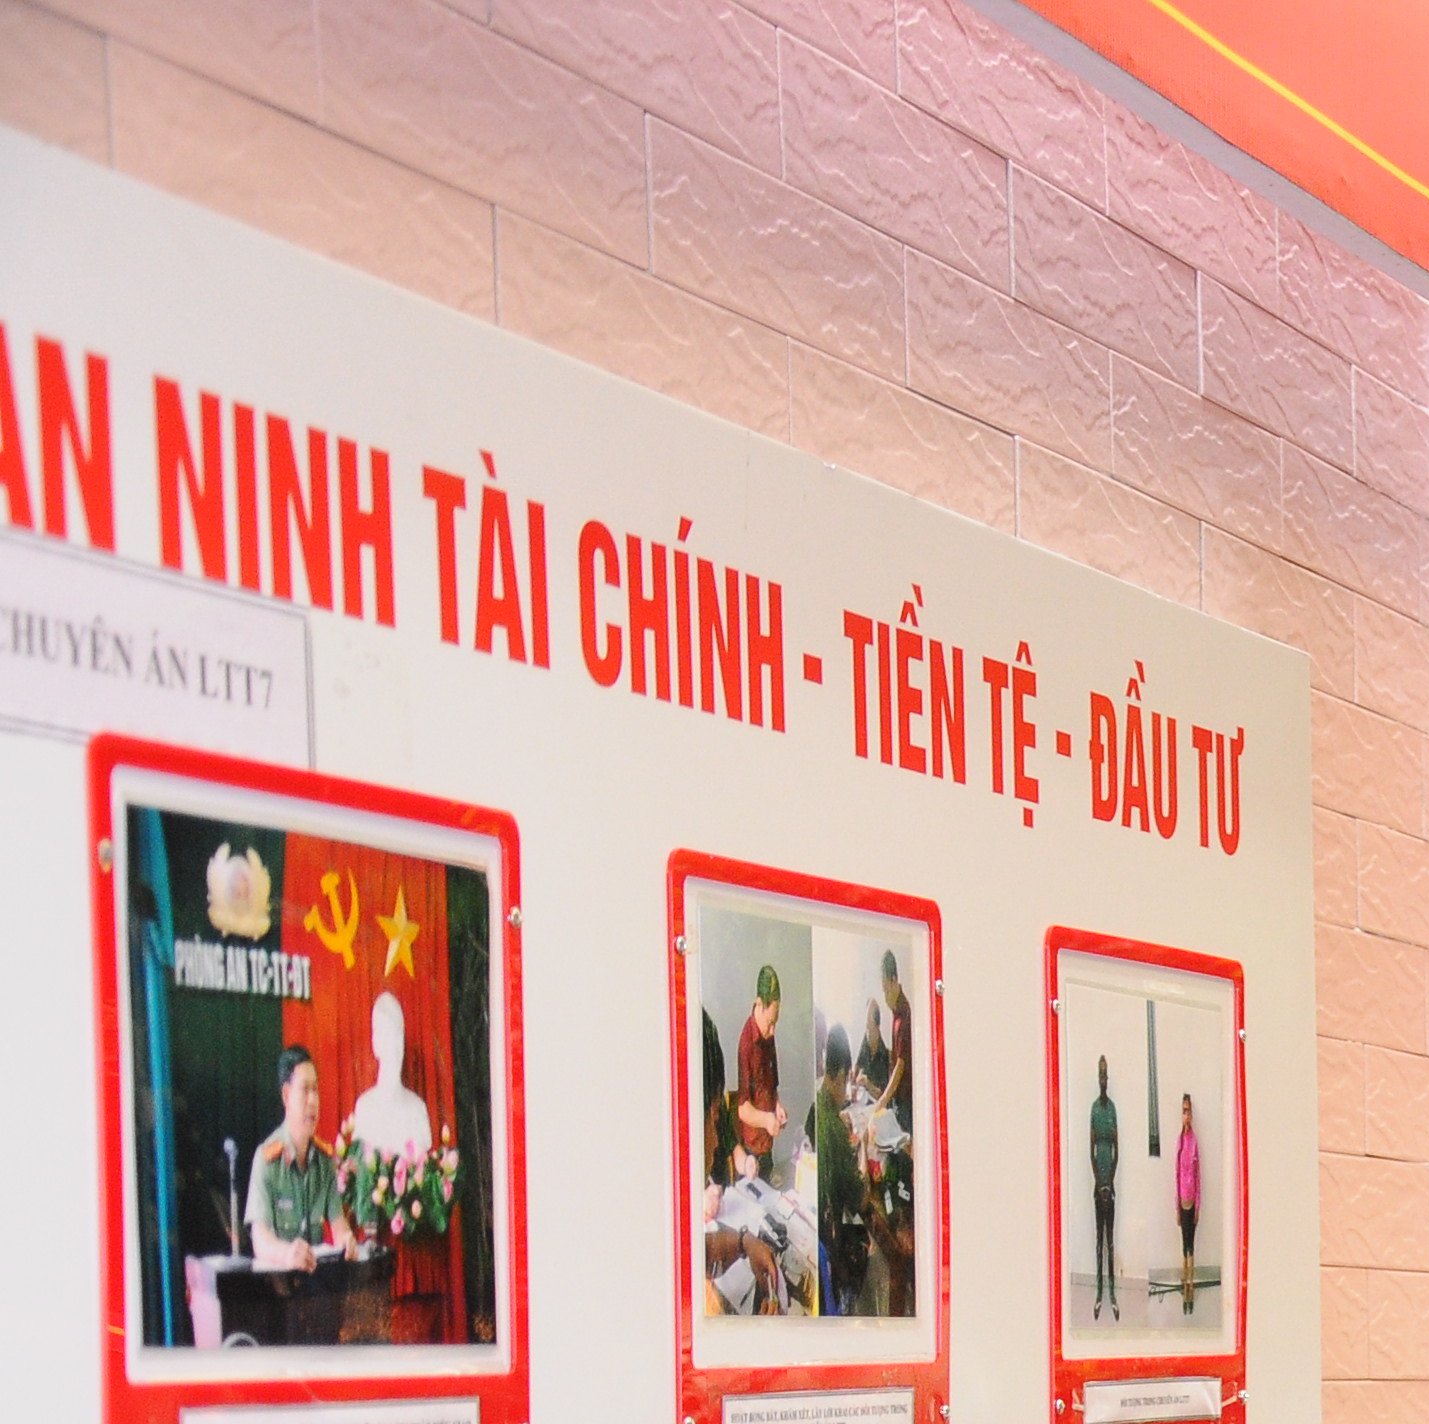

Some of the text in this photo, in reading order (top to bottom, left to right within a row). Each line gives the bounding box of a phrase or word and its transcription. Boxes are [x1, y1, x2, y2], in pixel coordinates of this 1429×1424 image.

[0, 606, 273, 709] HUYÊN ÁN LTT7
[155, 377, 396, 627] NINH
[423, 452, 550, 669] TÀI
[579, 517, 785, 732] CHÍNH
[804, 654, 823, 684] -
[844, 584, 966, 784] TIỀN
[983, 641, 1039, 828] TỆ
[1057, 731, 1071, 757] -
[1089, 661, 1178, 839] ĐẦU
[1192, 726, 1244, 855] TƯ
